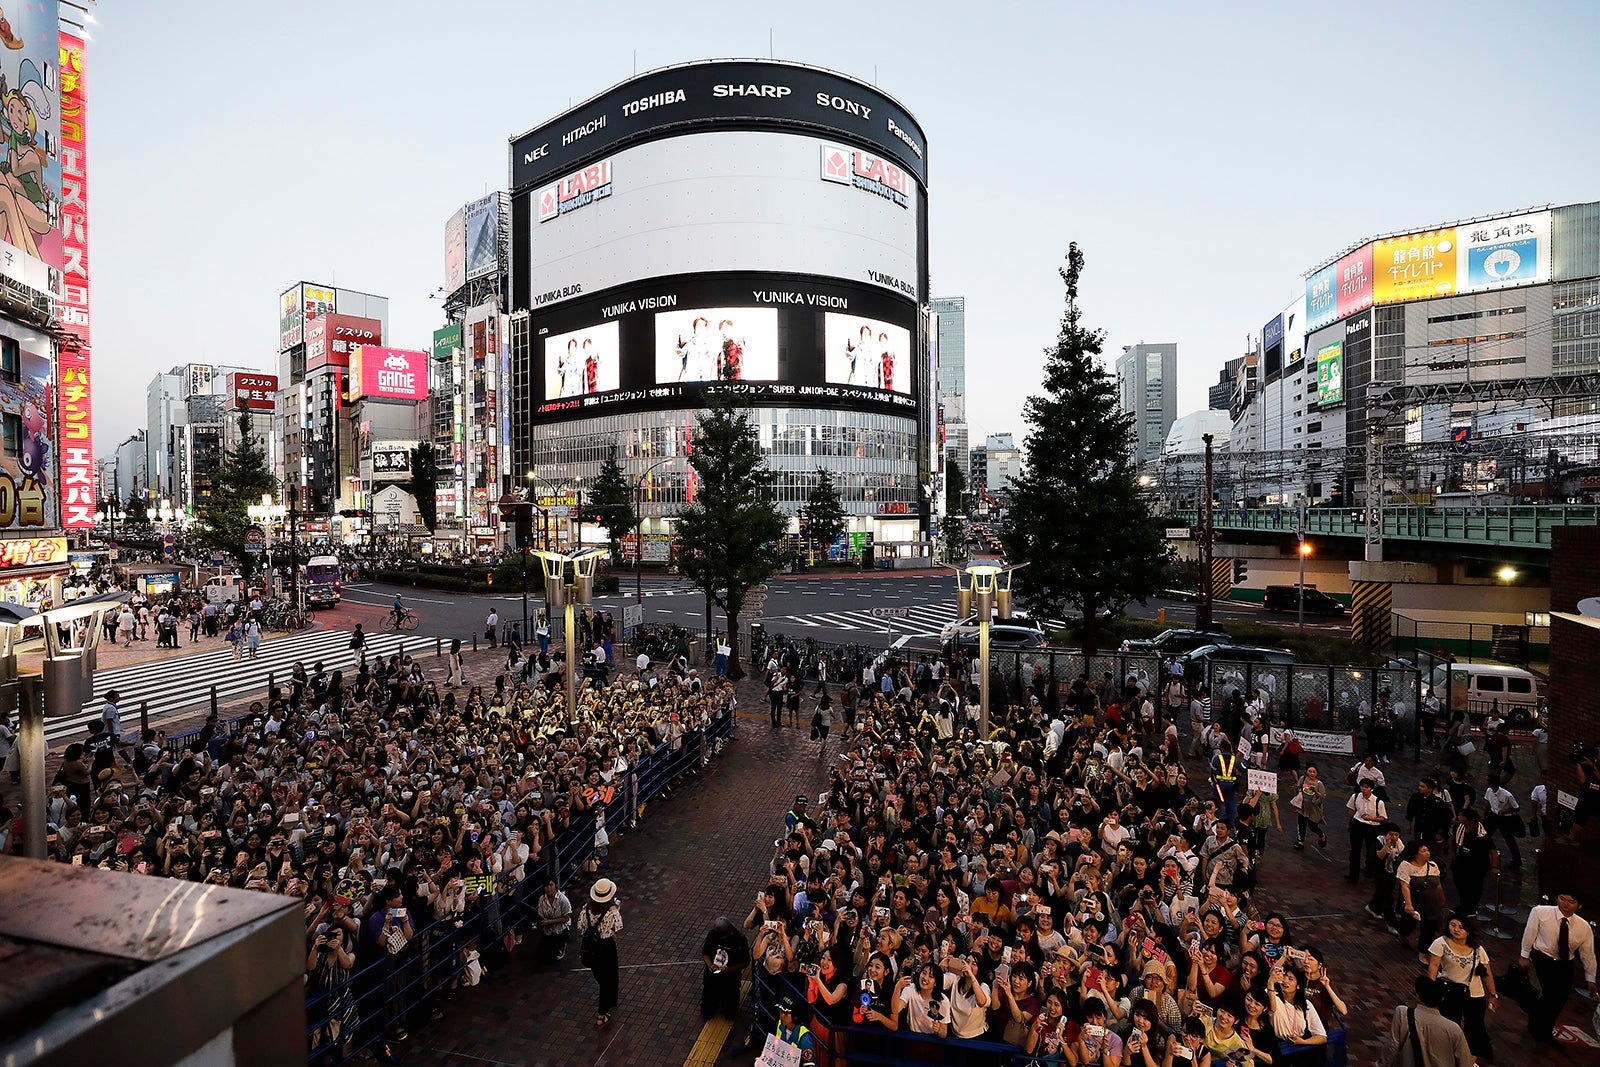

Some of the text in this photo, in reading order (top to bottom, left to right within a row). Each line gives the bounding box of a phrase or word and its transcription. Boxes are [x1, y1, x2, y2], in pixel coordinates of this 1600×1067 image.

[713, 84, 792, 98] SHARP
[622, 88, 686, 117] TOSHIBA
[816, 92, 872, 120] SONY
[562, 115, 607, 147] HITACHI
[887, 117, 923, 159] Panasonic
[524, 143, 549, 165] NEC
[559, 162, 607, 201] LABI
[855, 151, 909, 194] LABI
[1471, 223, 1534, 243] 龍角散
[1393, 244, 1436, 264] 龍角散
[868, 269, 899, 289] YUNIKA
[1387, 262, 1444, 281] ダイレクト
[534, 284, 583, 305] YUNIKA BLDG.
[753, 291, 848, 309] YUNIKA VISION
[602, 294, 677, 318] YUNIKA VISION
[335, 326, 374, 339] クスリの
[331, 339, 378, 355] 龍生
[240, 377, 272, 387] クスリの
[378, 370, 415, 388] GAME
[63, 367, 93, 524] パチンコ エスパス
[885, 502, 909, 514] LABI
[0, 540, 55, 567] 増台
[765, 1041, 800, 1064] 立ち止まらず
